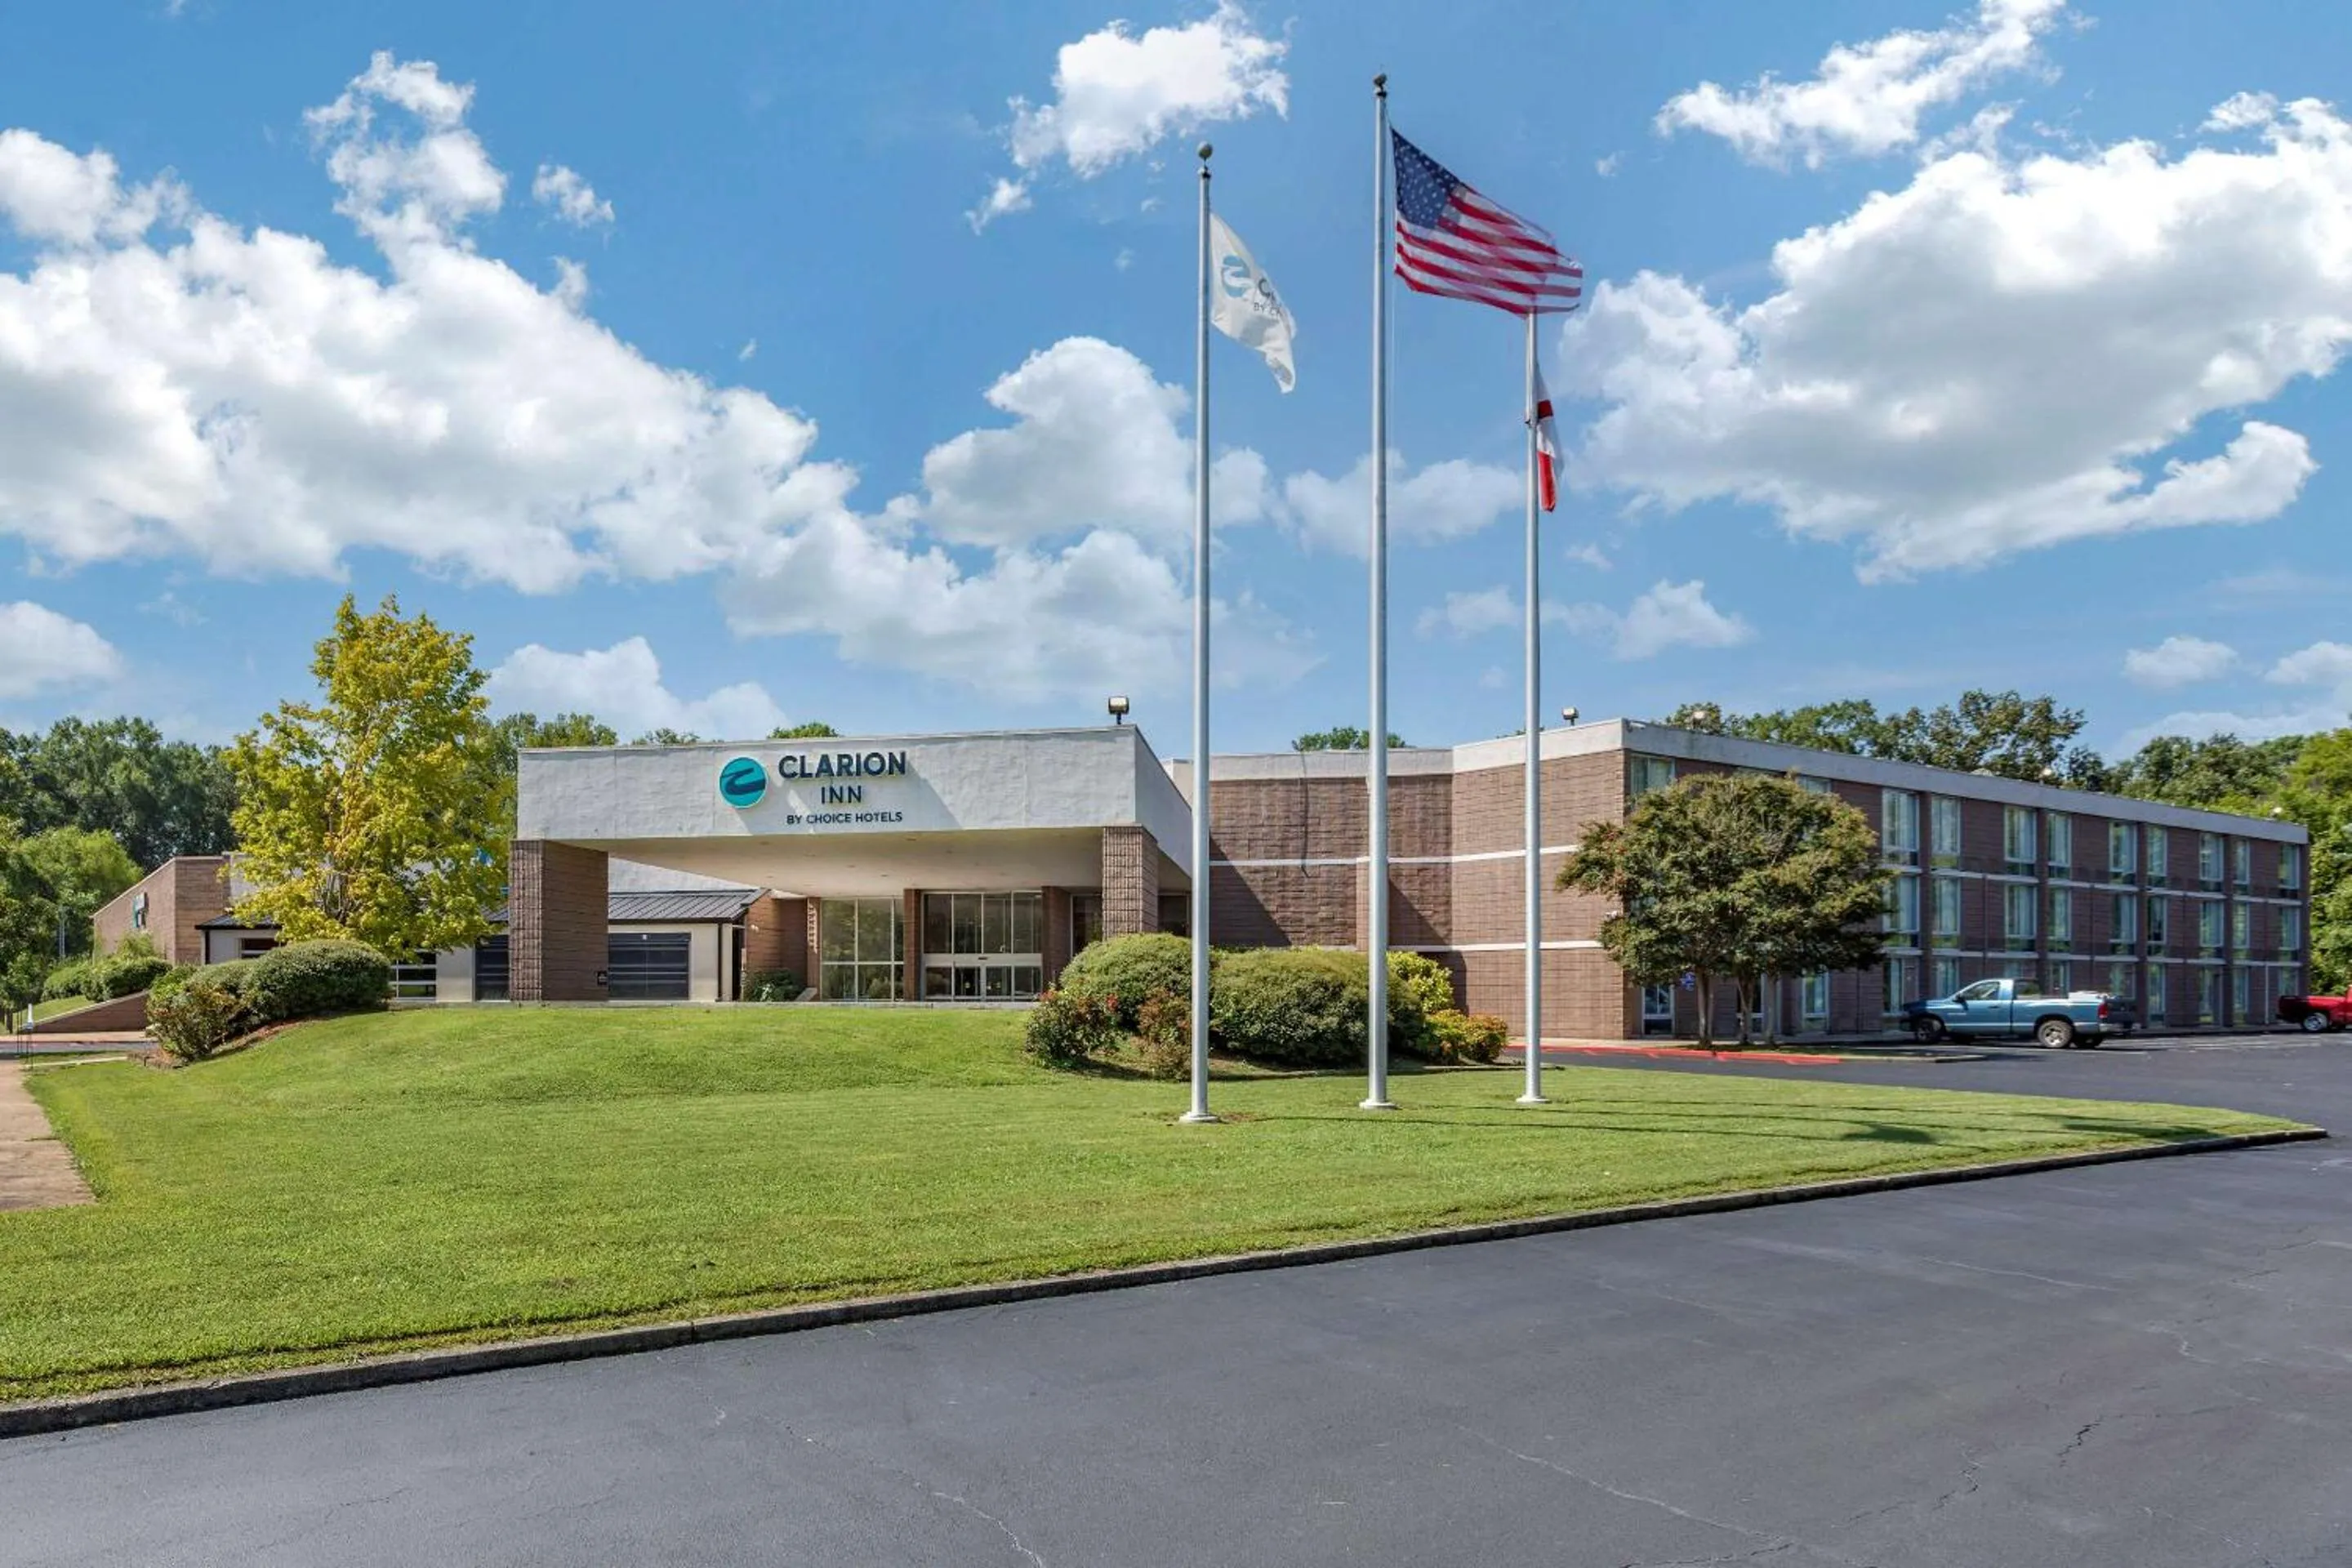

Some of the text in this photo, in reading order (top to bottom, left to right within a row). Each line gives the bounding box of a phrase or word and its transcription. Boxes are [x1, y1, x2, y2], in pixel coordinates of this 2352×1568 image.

[778, 751, 906, 778] CLARION
[821, 785, 862, 804] INN
[786, 812, 902, 825] BY CHOICE HOTELS
